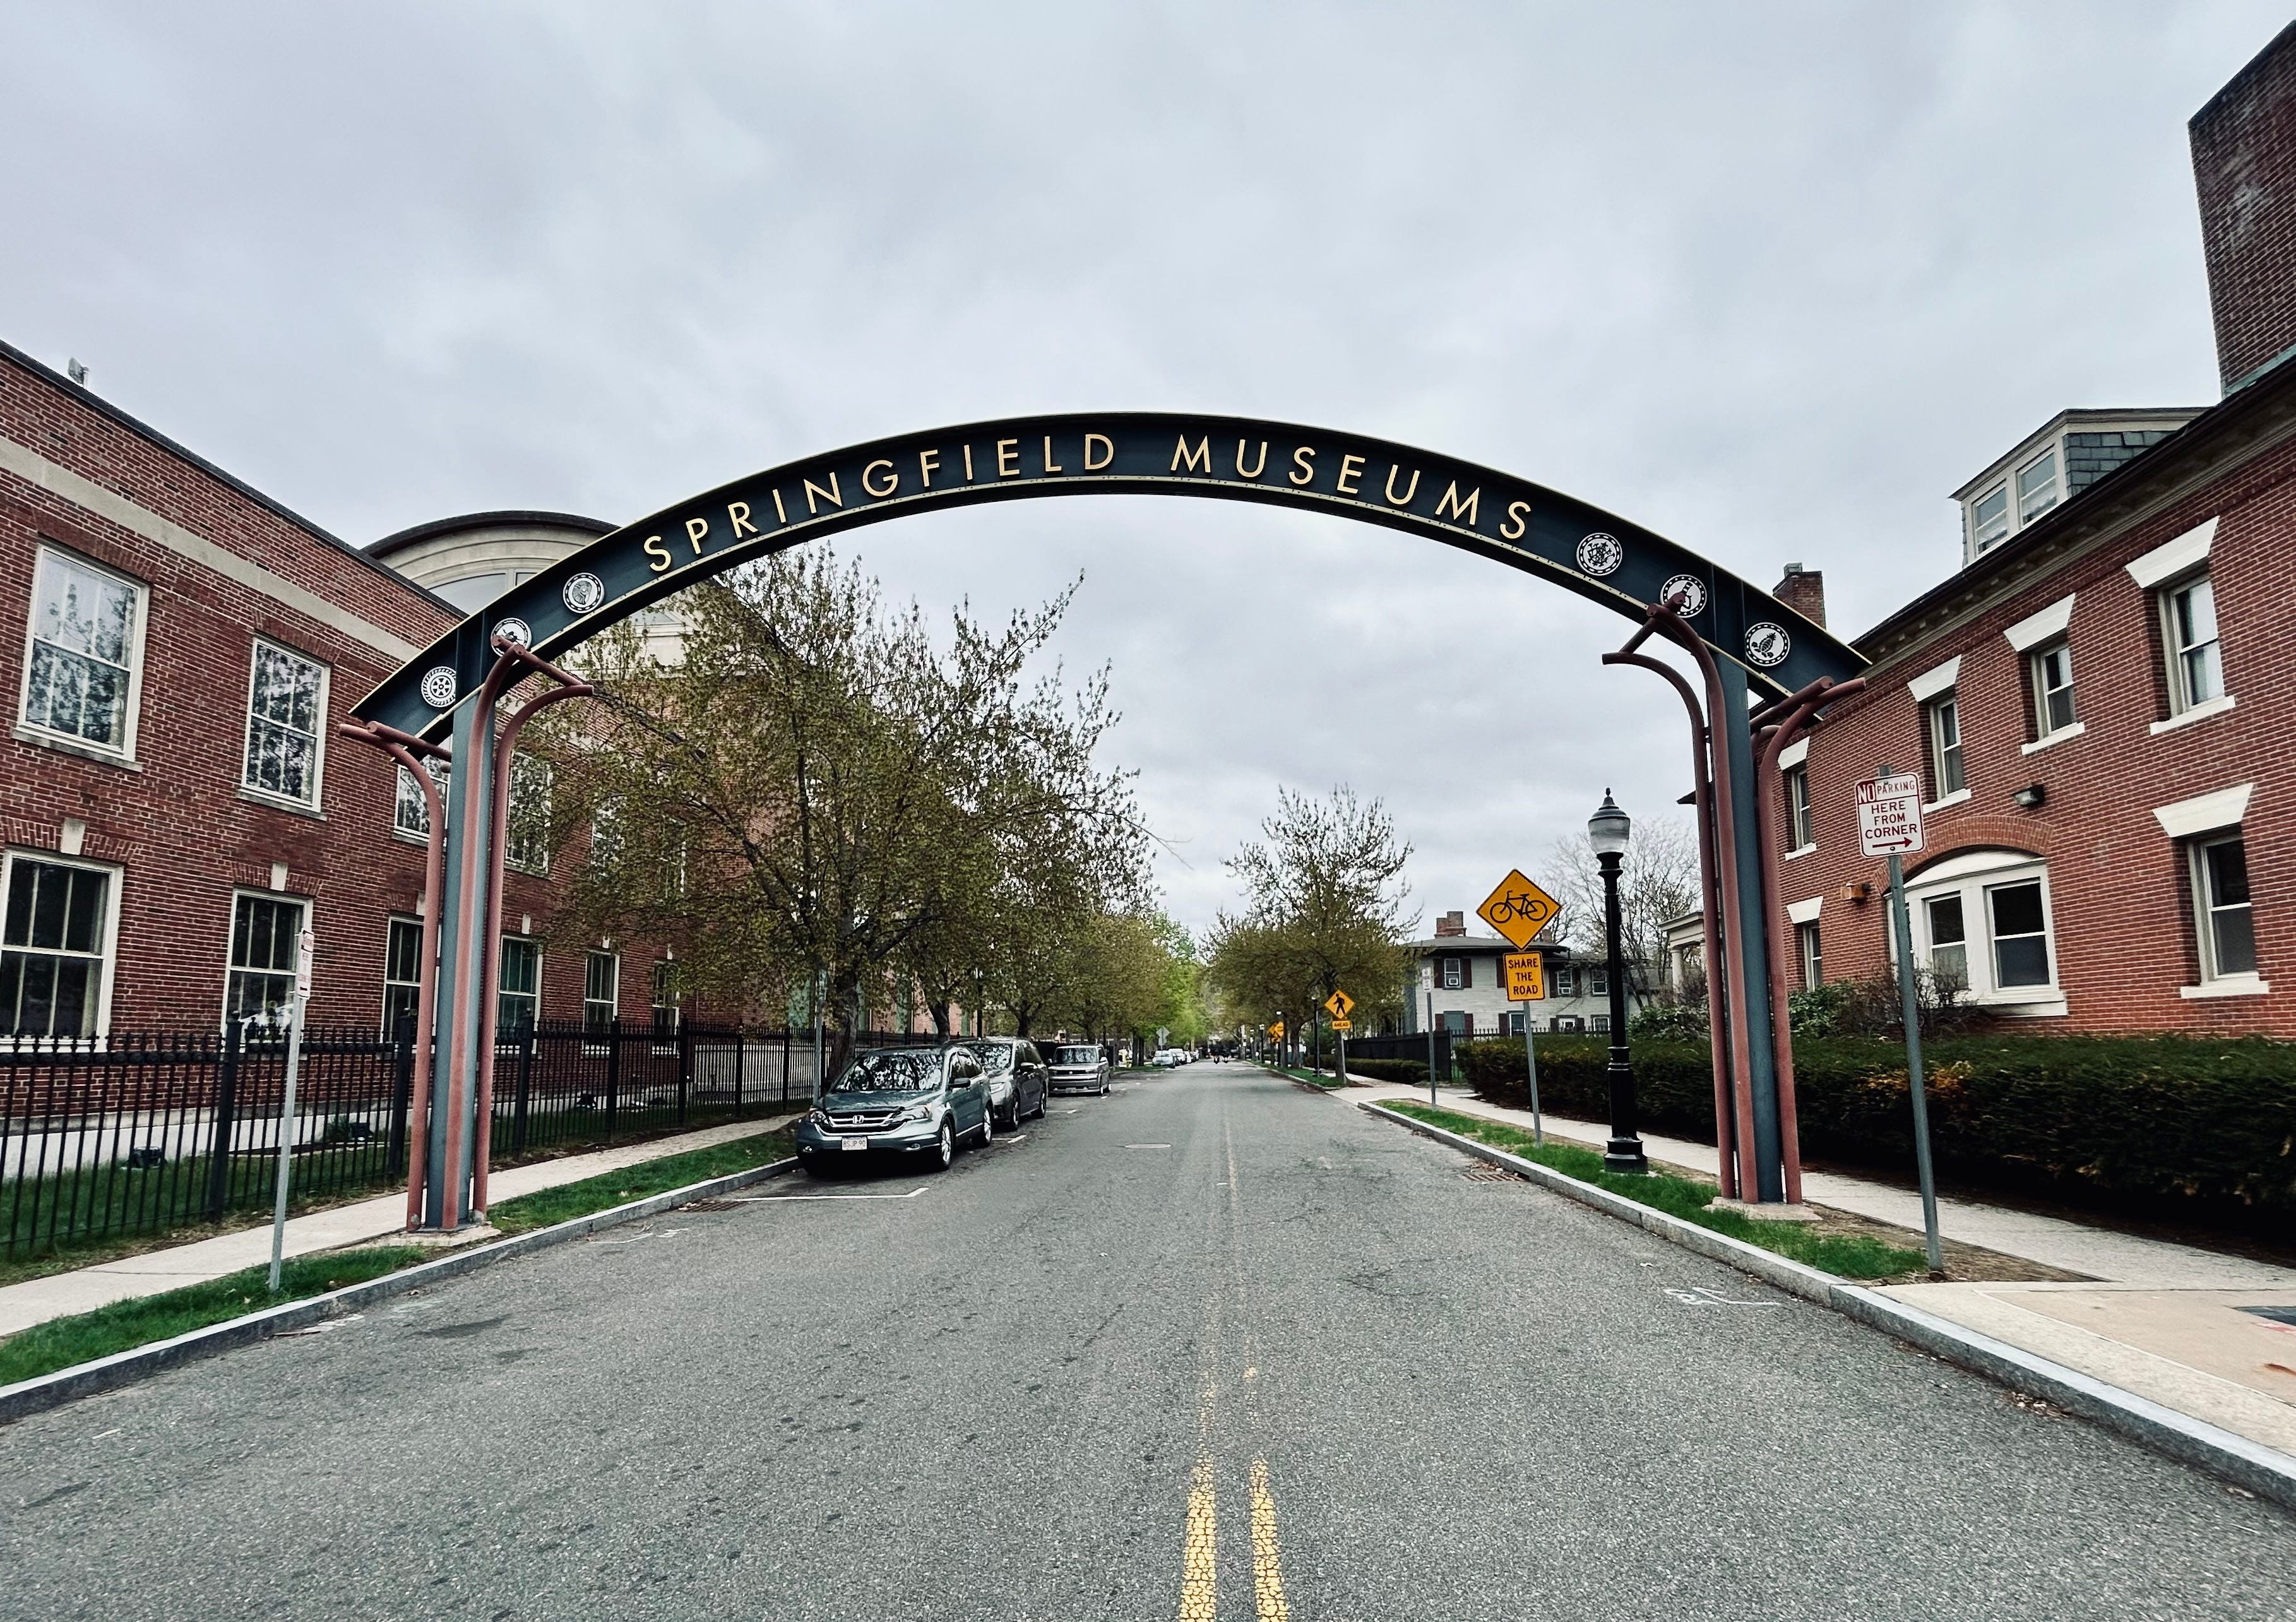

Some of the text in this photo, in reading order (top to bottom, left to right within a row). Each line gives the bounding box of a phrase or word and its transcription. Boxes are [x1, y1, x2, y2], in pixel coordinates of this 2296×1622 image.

[644, 434, 1531, 571] SPRINGFIELD MUSEUMS
[1857, 780, 1915, 804] NO PARKING
[1871, 801, 1906, 814] HERE
[1874, 813, 1905, 826] FROM
[1865, 824, 1917, 838] CORNER
[1508, 958, 1538, 969] SHARE
[1515, 972, 1533, 981] THE
[1513, 985, 1538, 995] ROAD
